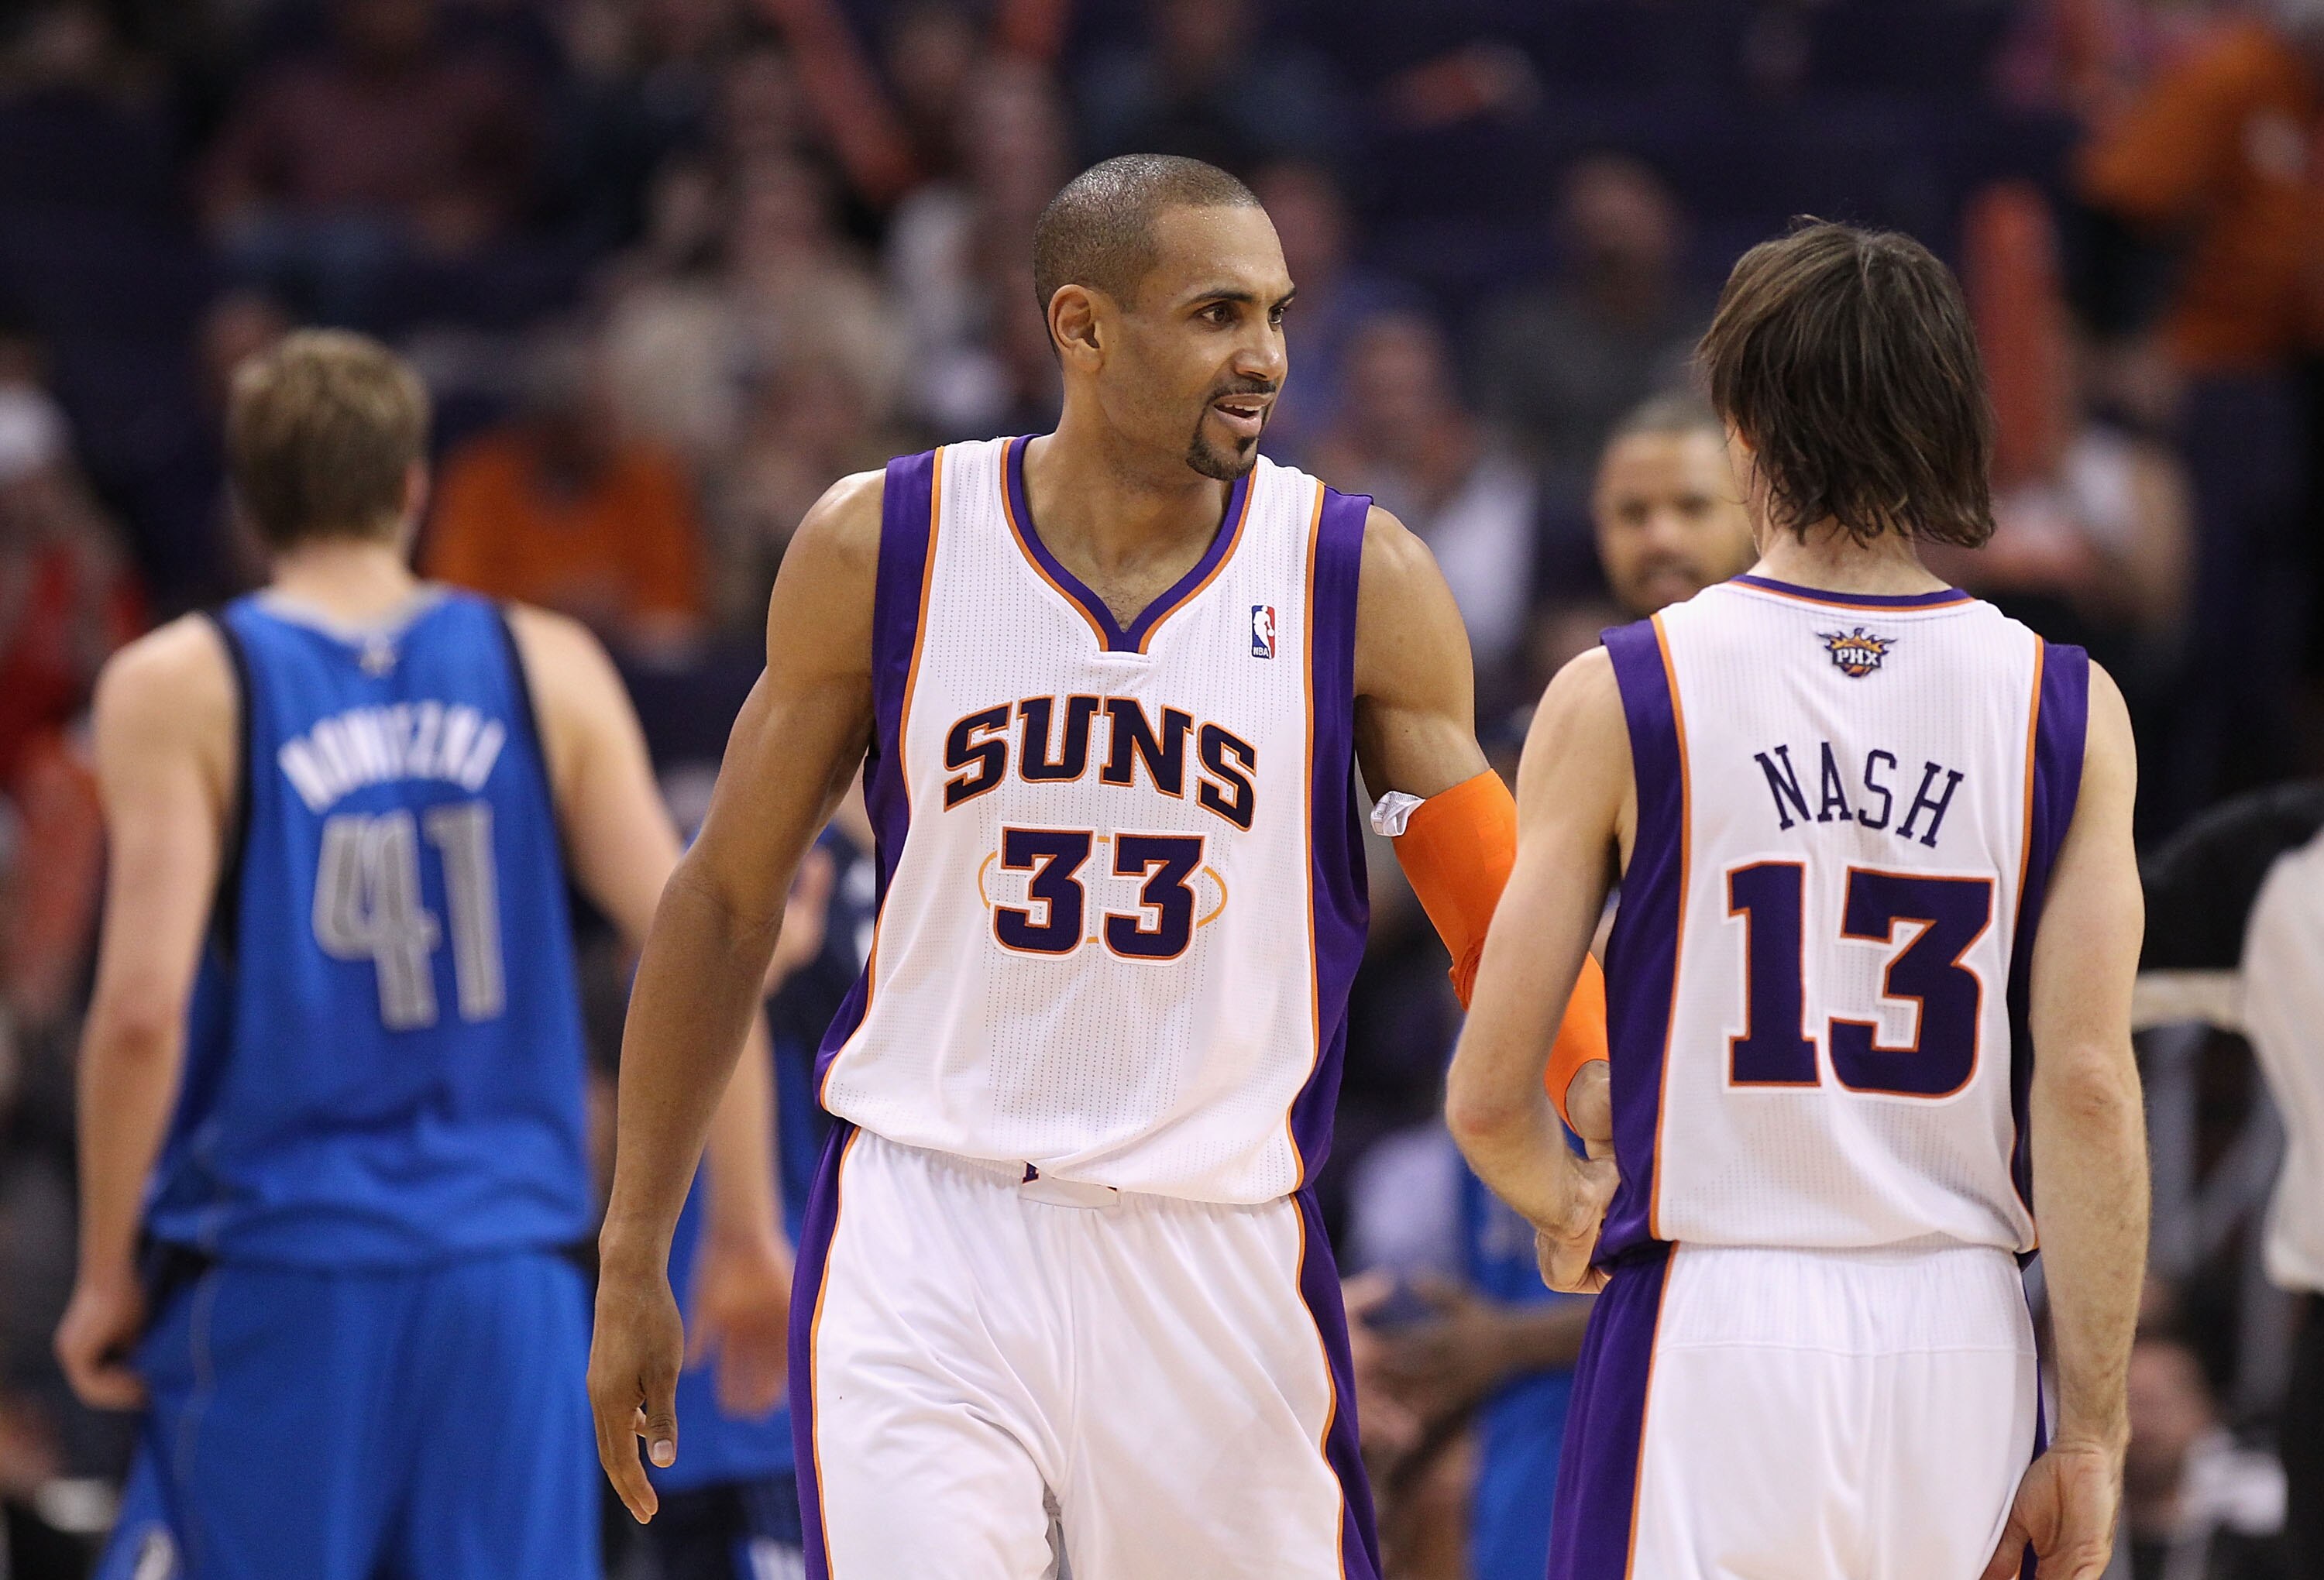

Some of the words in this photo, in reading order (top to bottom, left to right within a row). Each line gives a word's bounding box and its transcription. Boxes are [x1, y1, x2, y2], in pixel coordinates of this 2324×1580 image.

[1253, 646, 1269, 658] NBA
[1837, 648, 1878, 665] PHX
[944, 694, 1257, 832] SUNS
[1755, 742, 1965, 847] NASH
[314, 801, 506, 1029] 41
[992, 826, 1206, 960] 33
[1727, 860, 1996, 1099] 13
